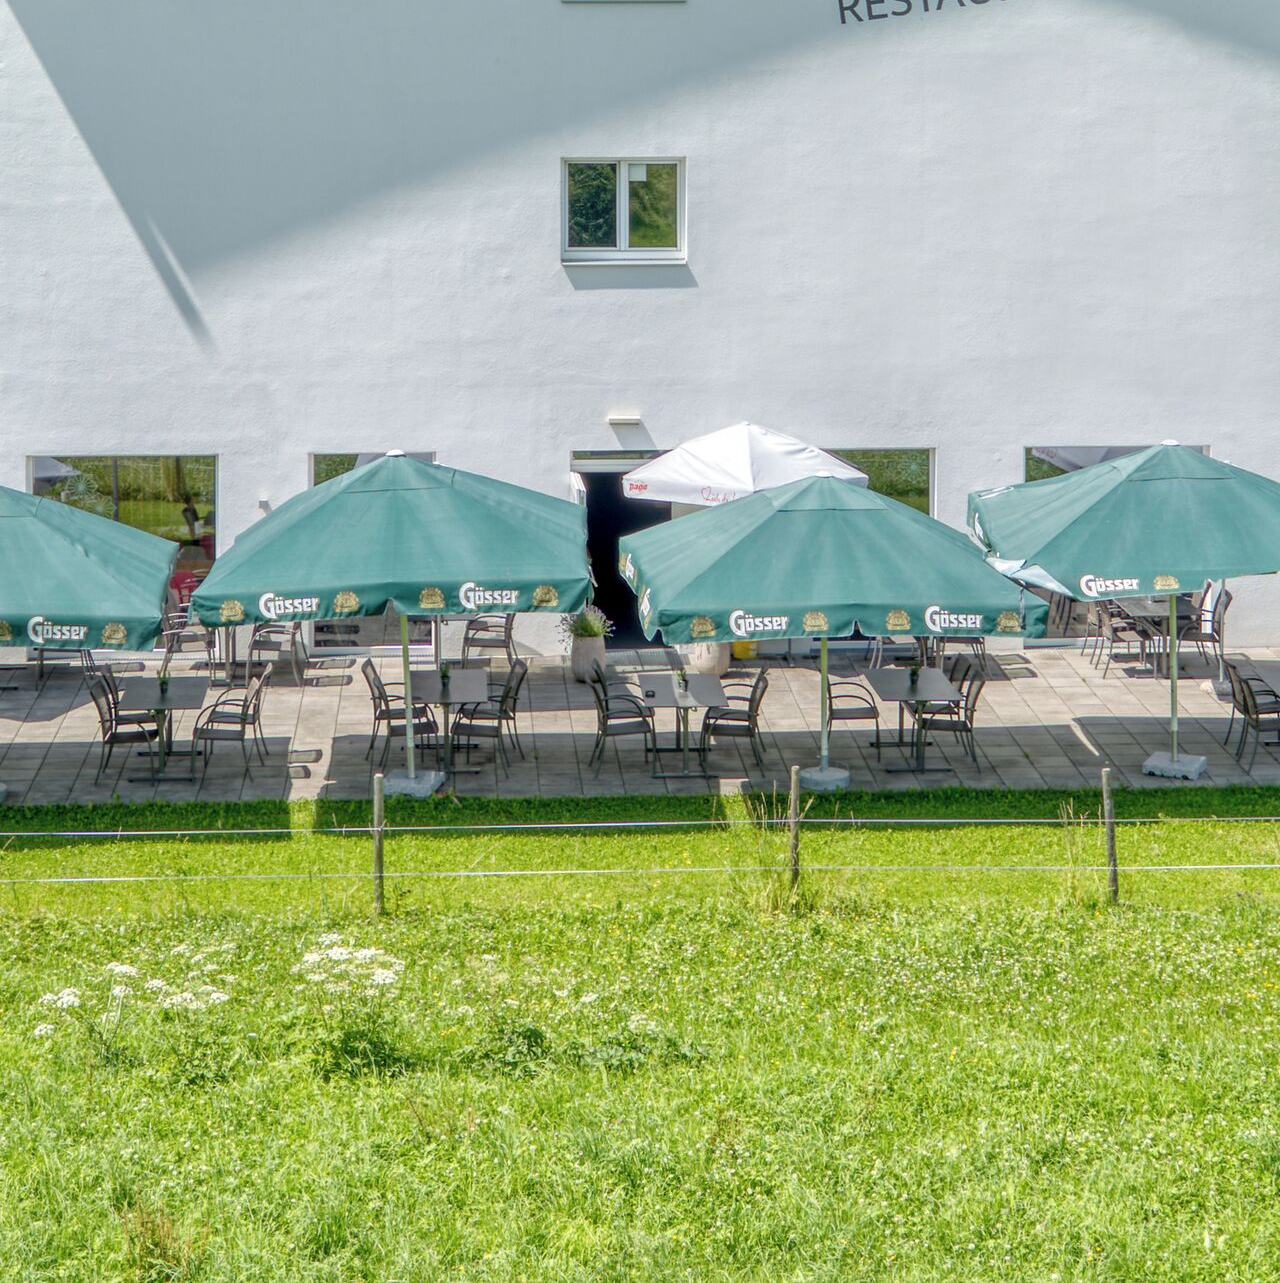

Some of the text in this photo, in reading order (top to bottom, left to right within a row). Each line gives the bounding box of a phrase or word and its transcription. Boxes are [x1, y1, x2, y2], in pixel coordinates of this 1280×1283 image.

[458, 581, 519, 610] Gösser
[1080, 574, 1140, 597] Gösser
[258, 591, 319, 619] Gösser
[924, 605, 984, 633] Gösser
[26, 615, 89, 644] Gösser
[728, 609, 789, 637] Gösser
